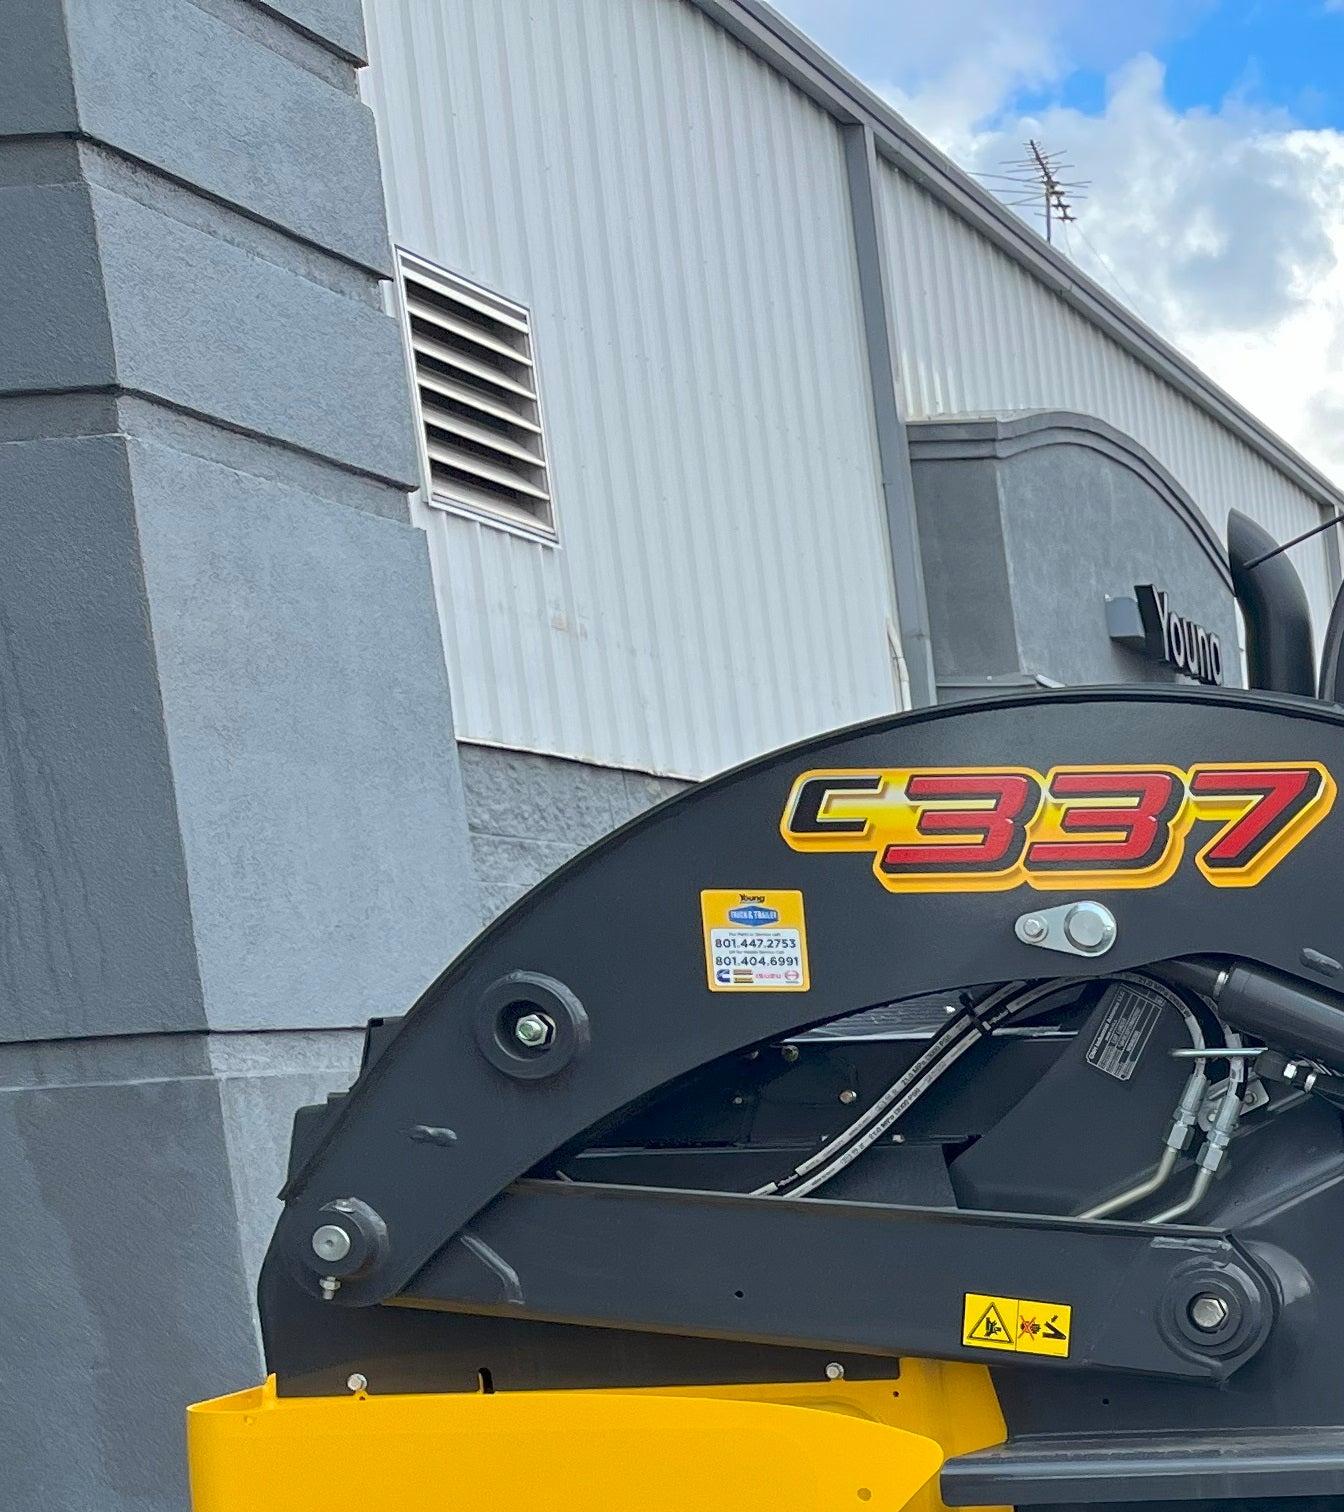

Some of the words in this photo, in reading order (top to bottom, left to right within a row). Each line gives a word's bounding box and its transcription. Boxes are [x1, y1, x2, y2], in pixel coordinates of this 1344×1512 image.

[784, 765, 1330, 886] C337
[739, 894, 766, 904] Young
[730, 910, 748, 919] TRUCK
[754, 910, 777, 919] TRAILER
[715, 939, 797, 949] 801.447.2753
[715, 957, 799, 966] 801.404.6991
